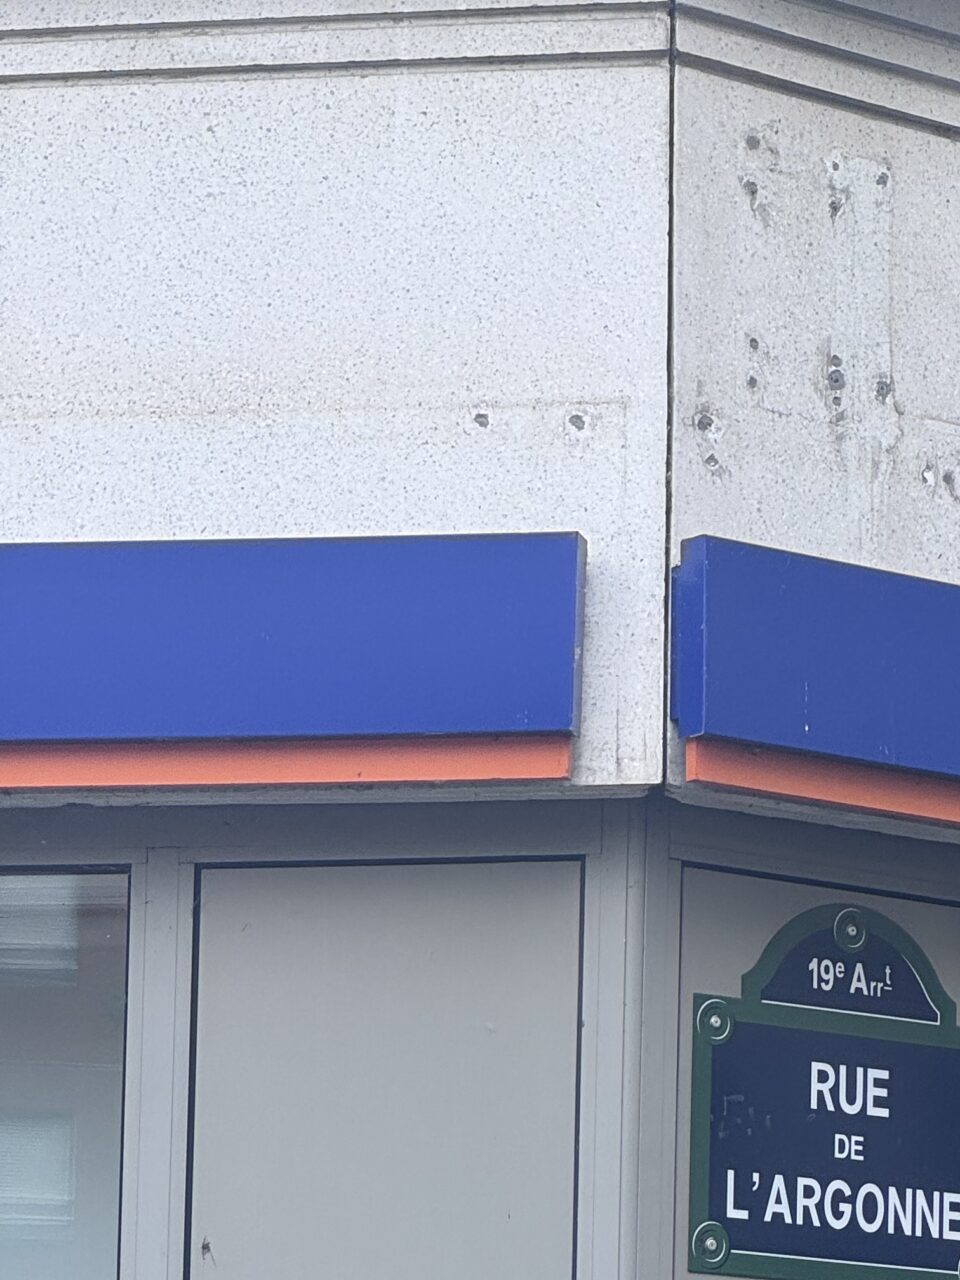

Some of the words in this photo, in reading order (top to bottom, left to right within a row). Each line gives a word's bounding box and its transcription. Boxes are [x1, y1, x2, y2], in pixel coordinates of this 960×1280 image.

[808, 957, 845, 991] 19e
[850, 962, 892, 997] Arrt
[810, 1061, 890, 1118] RUE
[834, 1133, 864, 1161] DE
